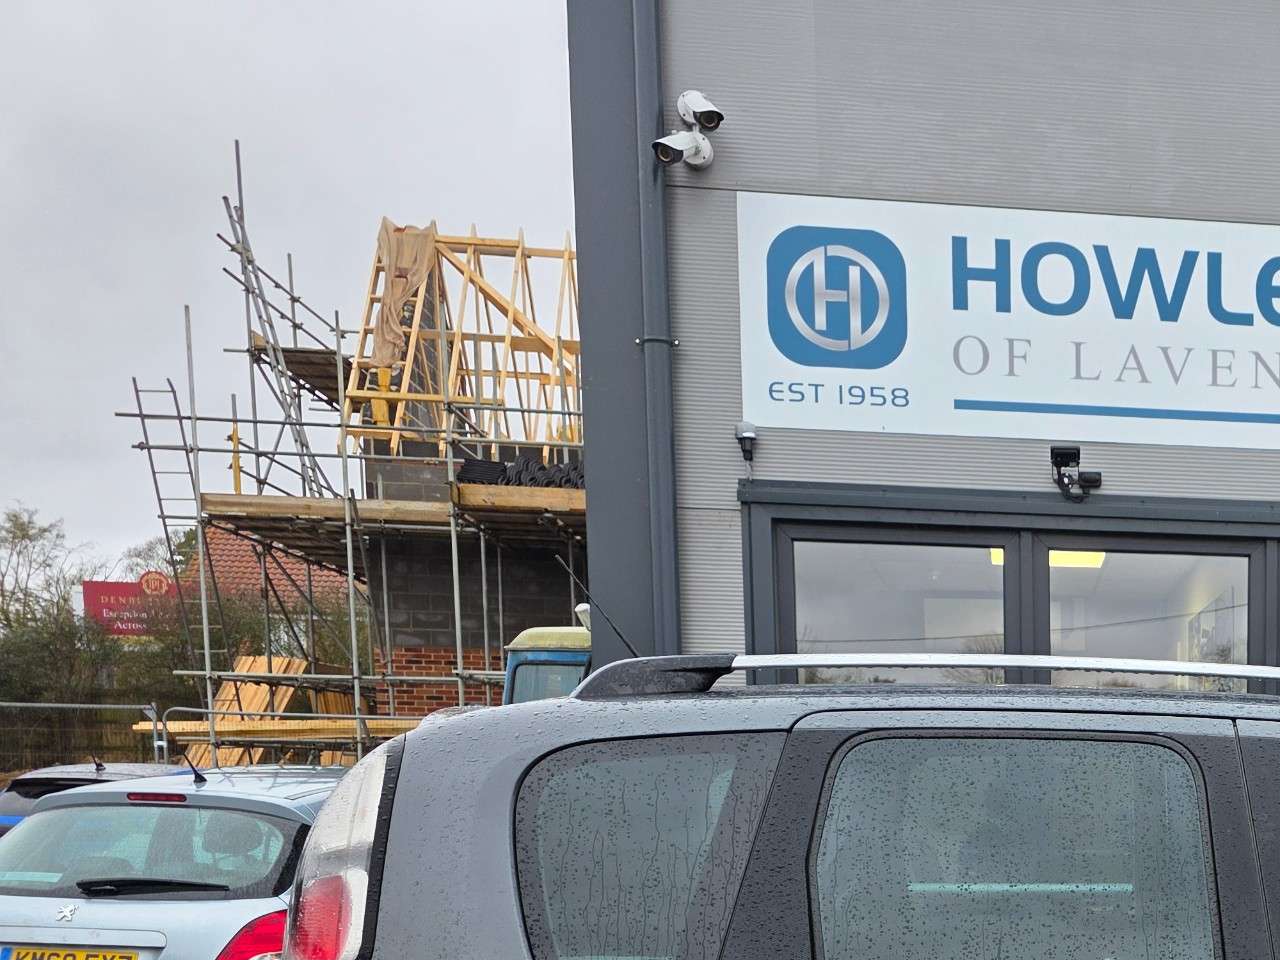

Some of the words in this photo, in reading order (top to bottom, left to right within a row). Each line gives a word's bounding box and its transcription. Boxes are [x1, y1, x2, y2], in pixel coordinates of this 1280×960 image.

[953, 335, 1032, 377] OF
[768, 381, 825, 403] EST
[839, 384, 910, 407] 1958
